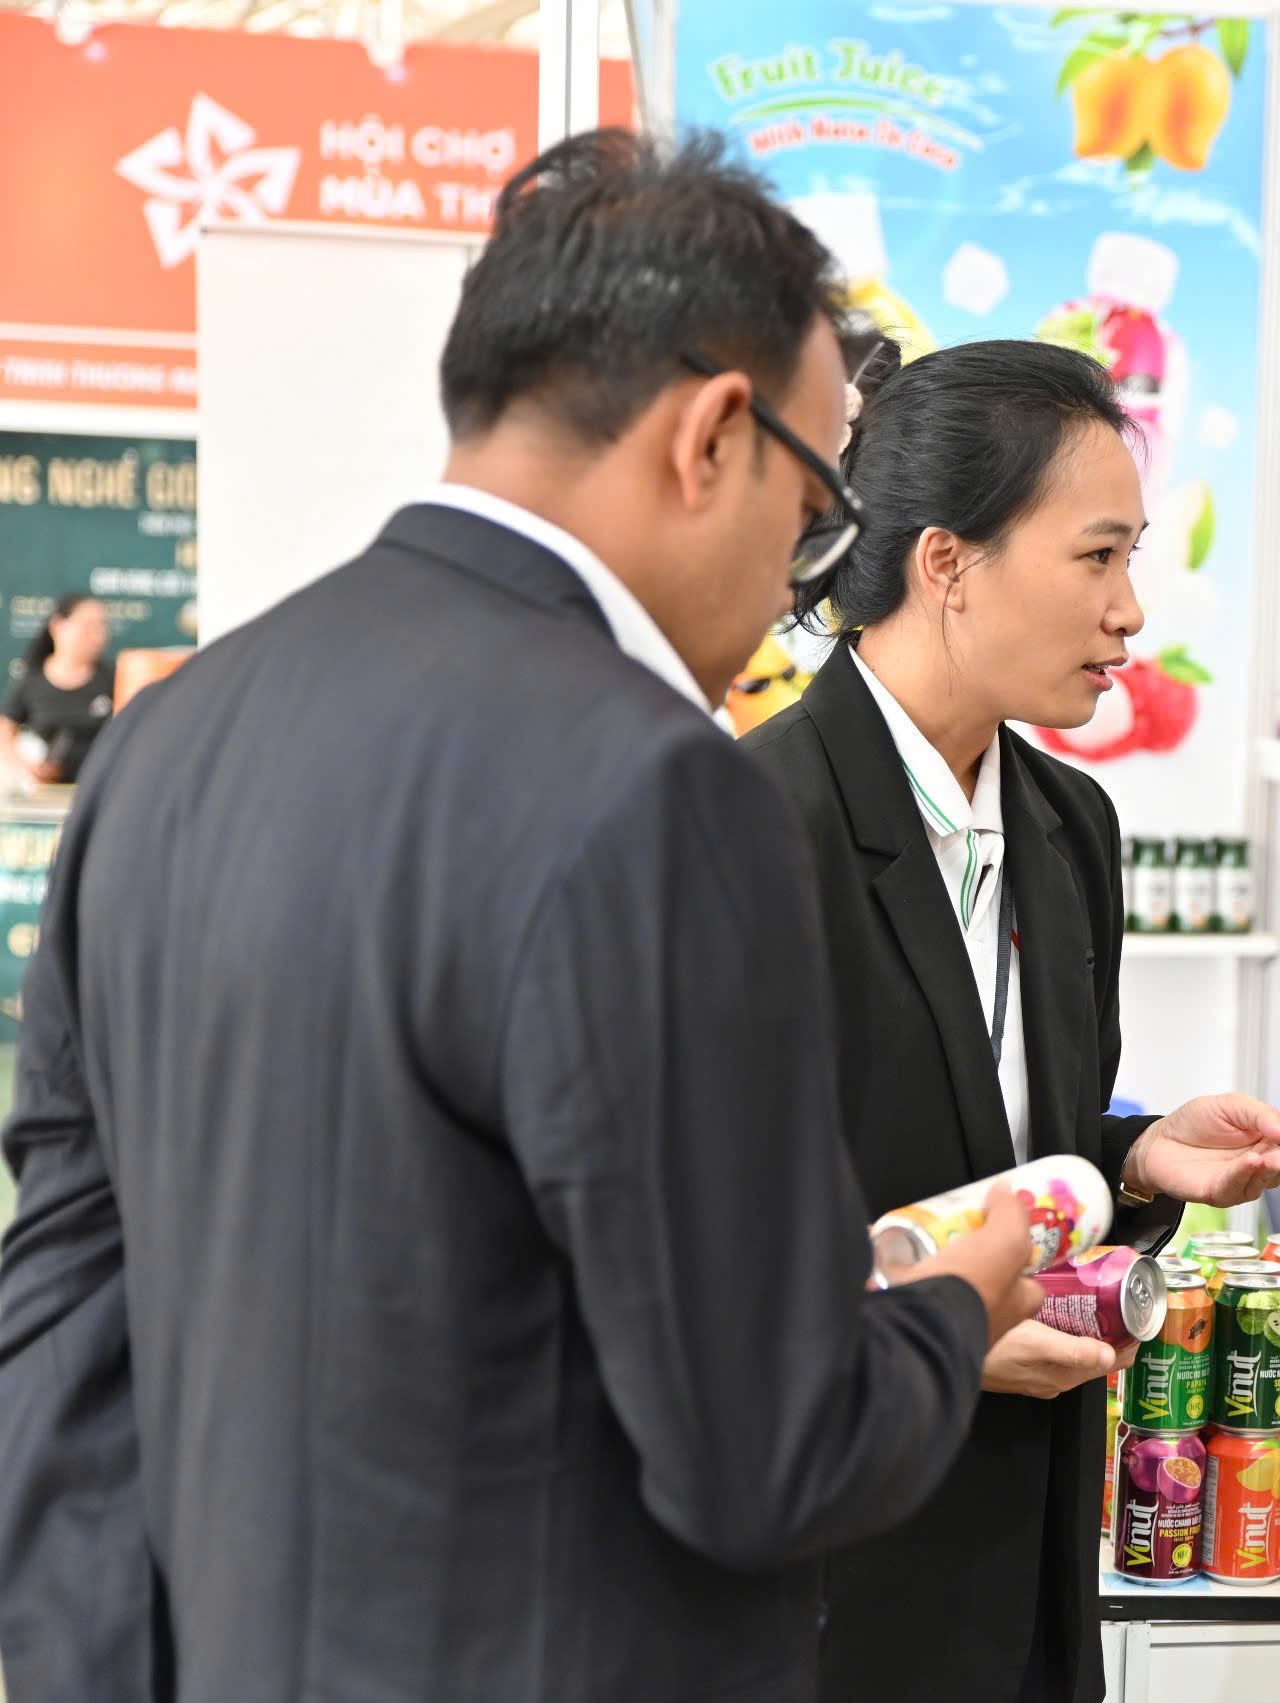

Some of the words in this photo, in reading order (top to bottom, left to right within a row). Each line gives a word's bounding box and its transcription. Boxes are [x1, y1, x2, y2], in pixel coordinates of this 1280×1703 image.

[712, 48, 818, 99] Fruit
[831, 40, 944, 102] Juice
[432, 180, 497, 224] TH
[1138, 1352, 1176, 1420] Vinut
[1224, 1350, 1261, 1417] Vinut
[1124, 1498, 1160, 1566] Vinut
[1160, 1528, 1189, 1538] PASSION
[1235, 1500, 1274, 1568] Vinut
